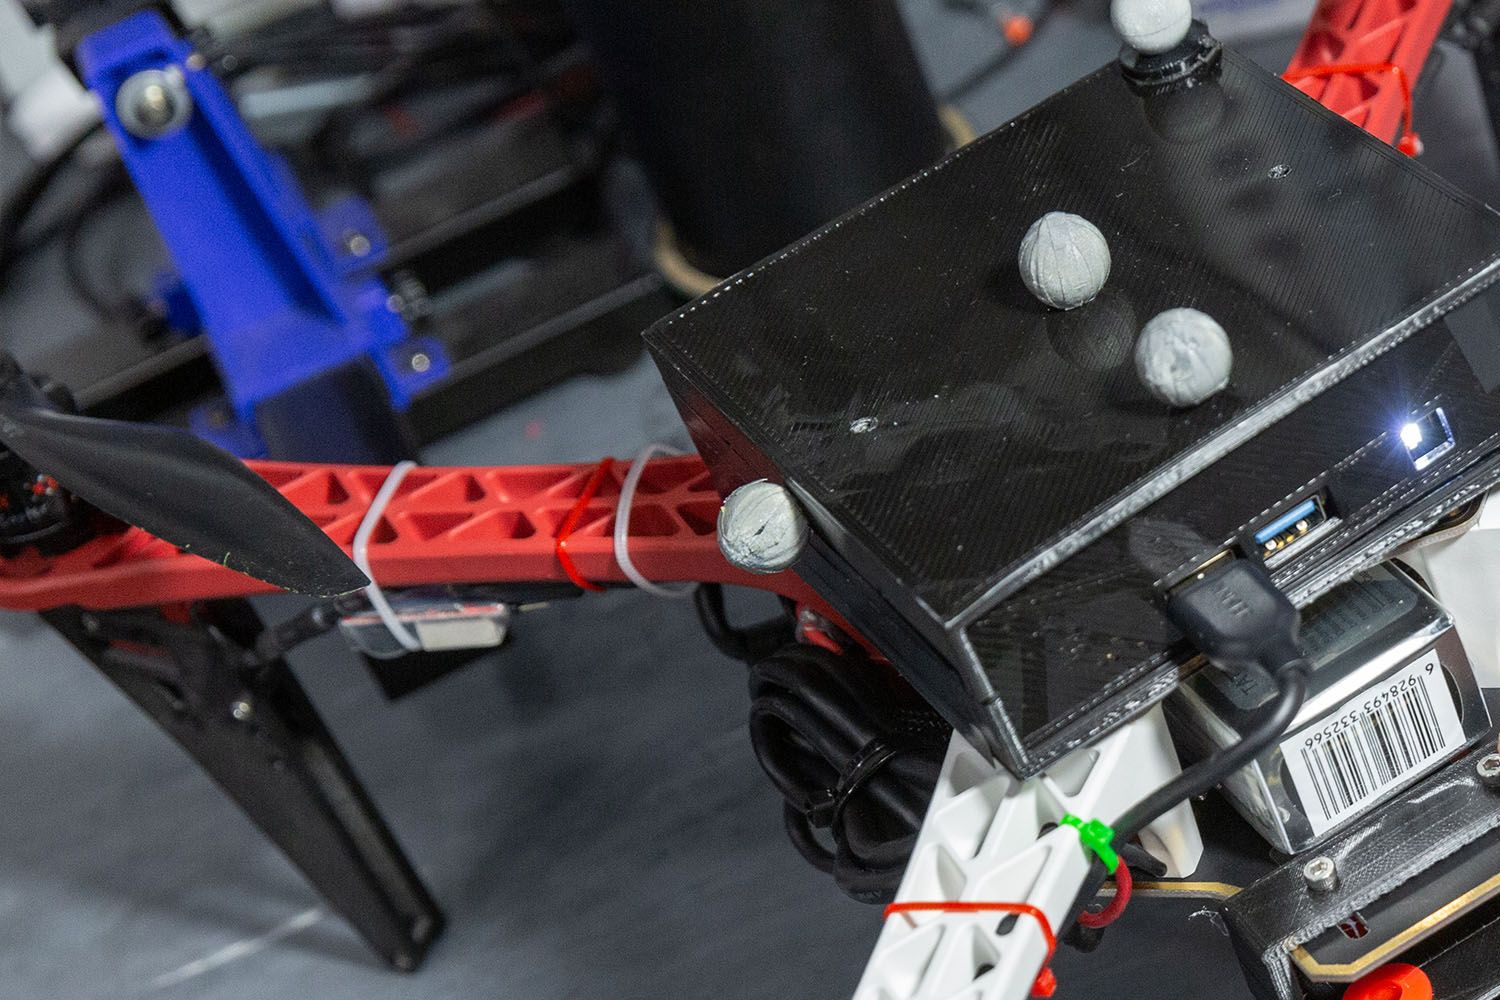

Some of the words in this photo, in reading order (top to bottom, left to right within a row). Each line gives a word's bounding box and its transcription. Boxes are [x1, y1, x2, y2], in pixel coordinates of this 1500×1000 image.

[1425, 662, 1435, 675] 6
[1363, 674, 1417, 714] 928493
[1304, 709, 1360, 750] 332566
